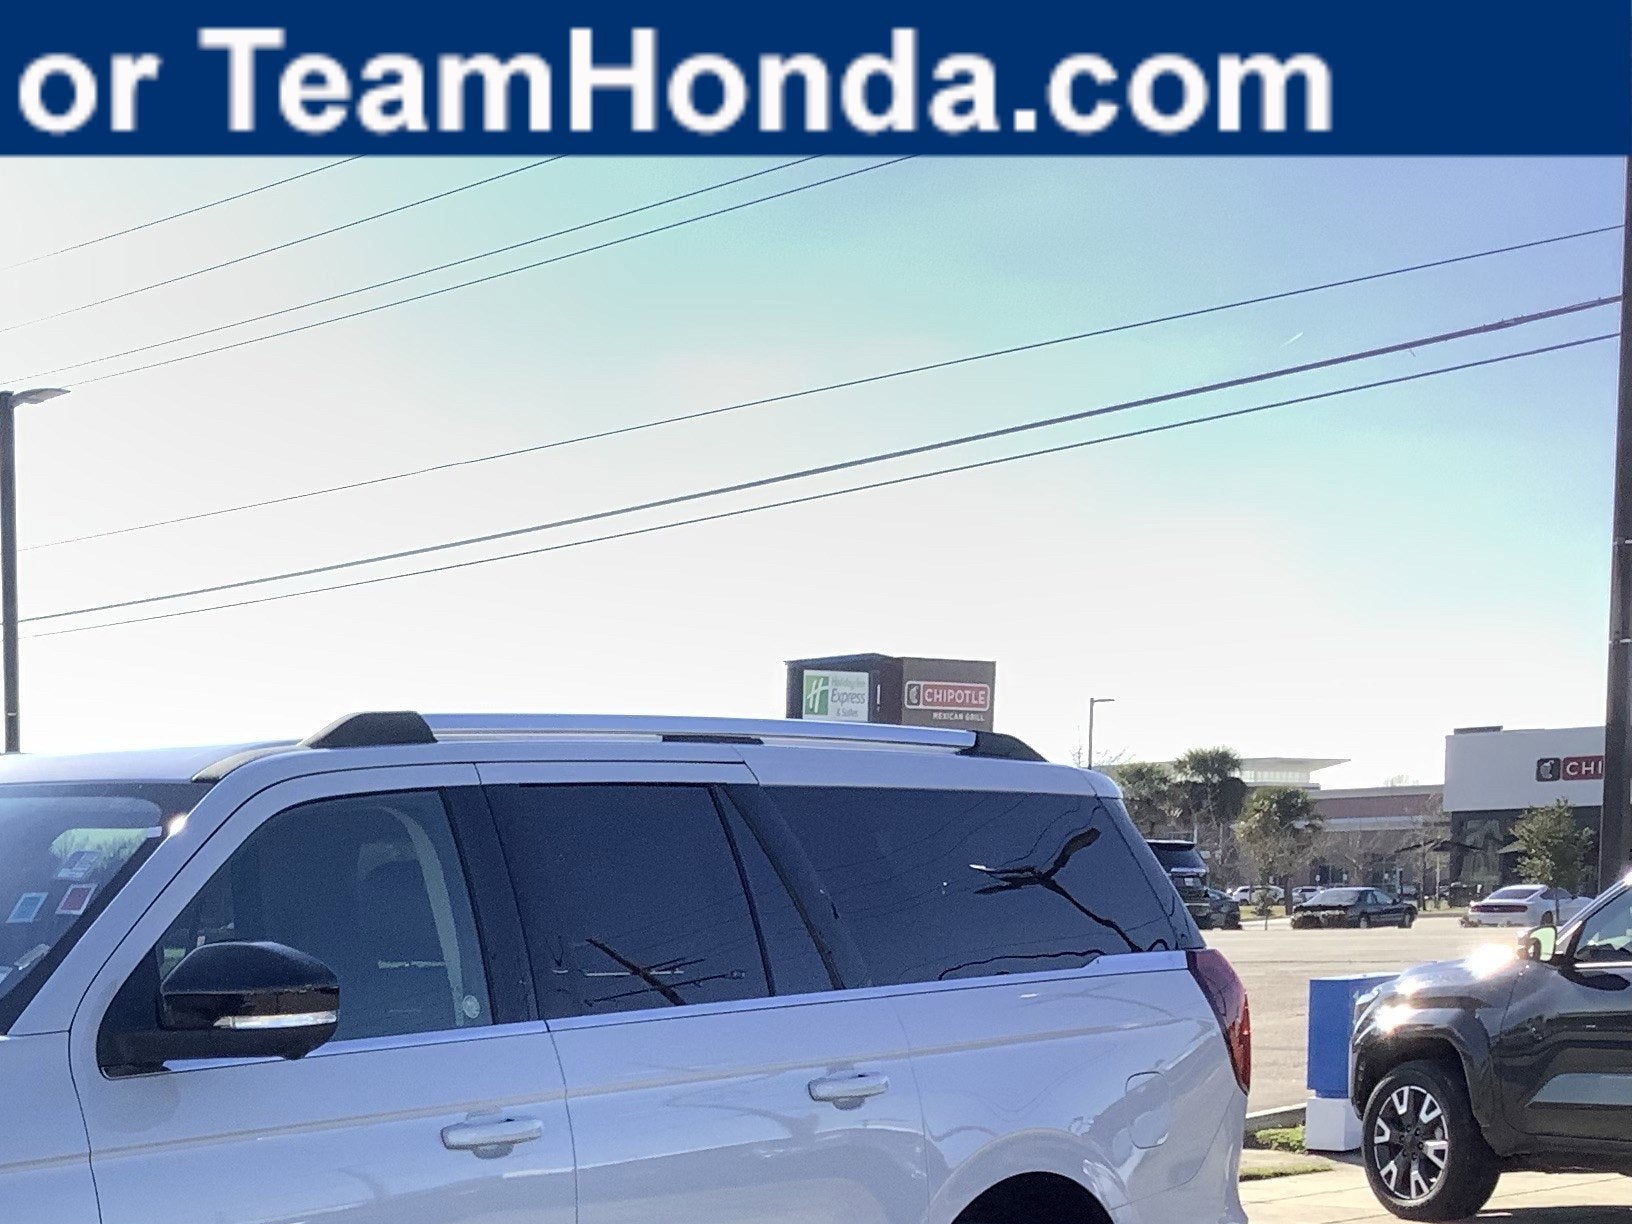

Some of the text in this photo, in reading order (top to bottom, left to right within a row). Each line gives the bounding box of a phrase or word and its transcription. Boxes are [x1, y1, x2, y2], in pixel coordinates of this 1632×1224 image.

[830, 688, 866, 706] Express
[924, 688, 986, 705] CHIPOTLE
[932, 712, 964, 720] MEXICAN
